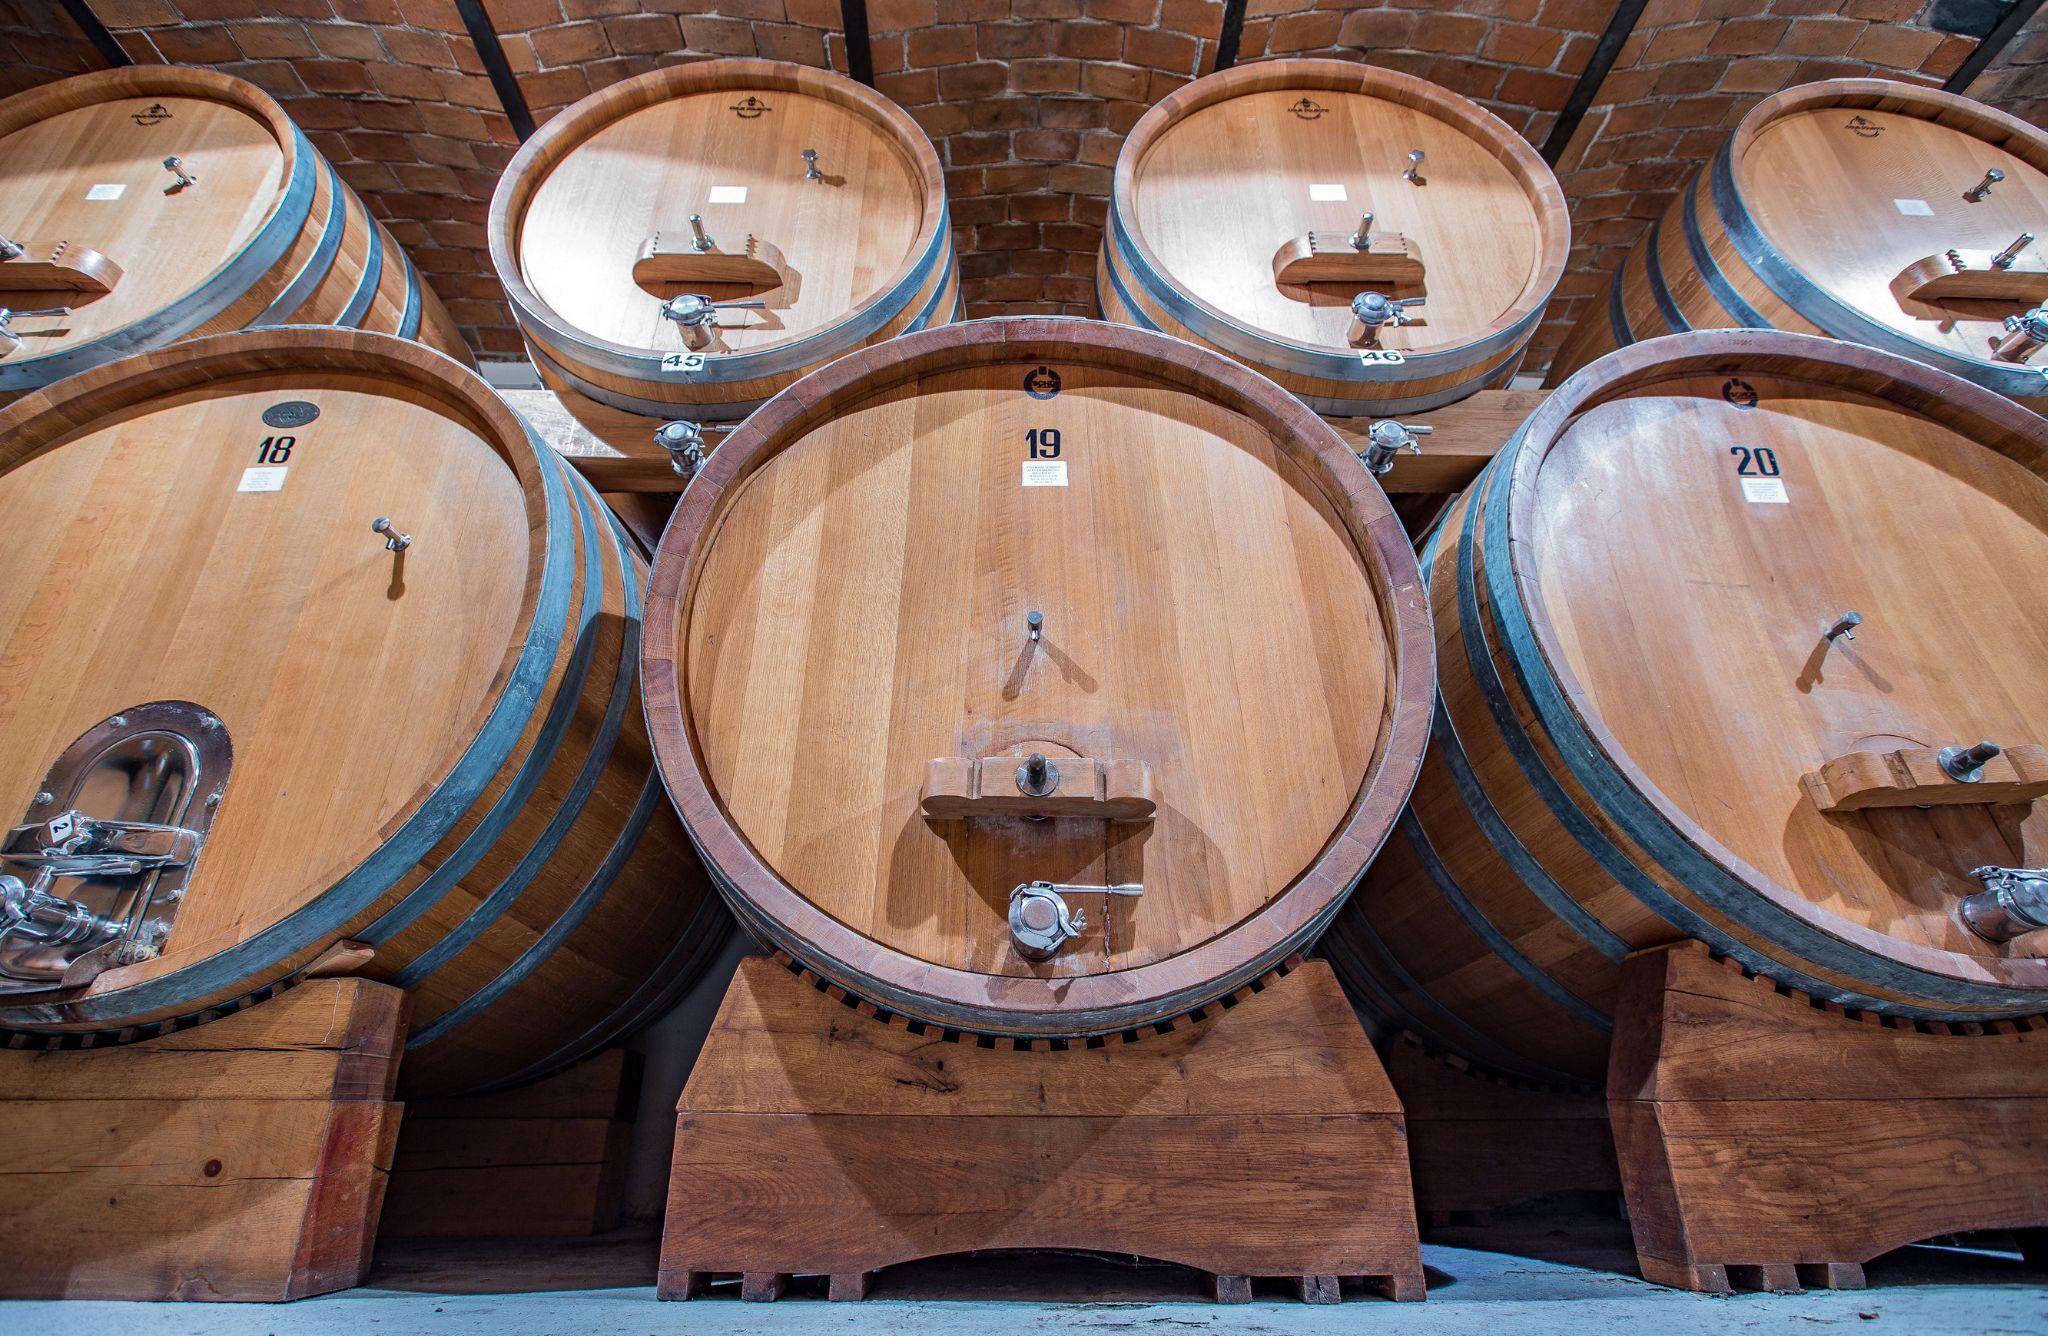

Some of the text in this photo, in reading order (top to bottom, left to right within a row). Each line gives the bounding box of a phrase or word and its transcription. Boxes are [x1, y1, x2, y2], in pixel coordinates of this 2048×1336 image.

[663, 354, 703, 366] 45
[1363, 351, 1401, 361] 46
[257, 436, 296, 464] 18
[1025, 428, 1061, 459] 19
[1730, 446, 1780, 476] 20
